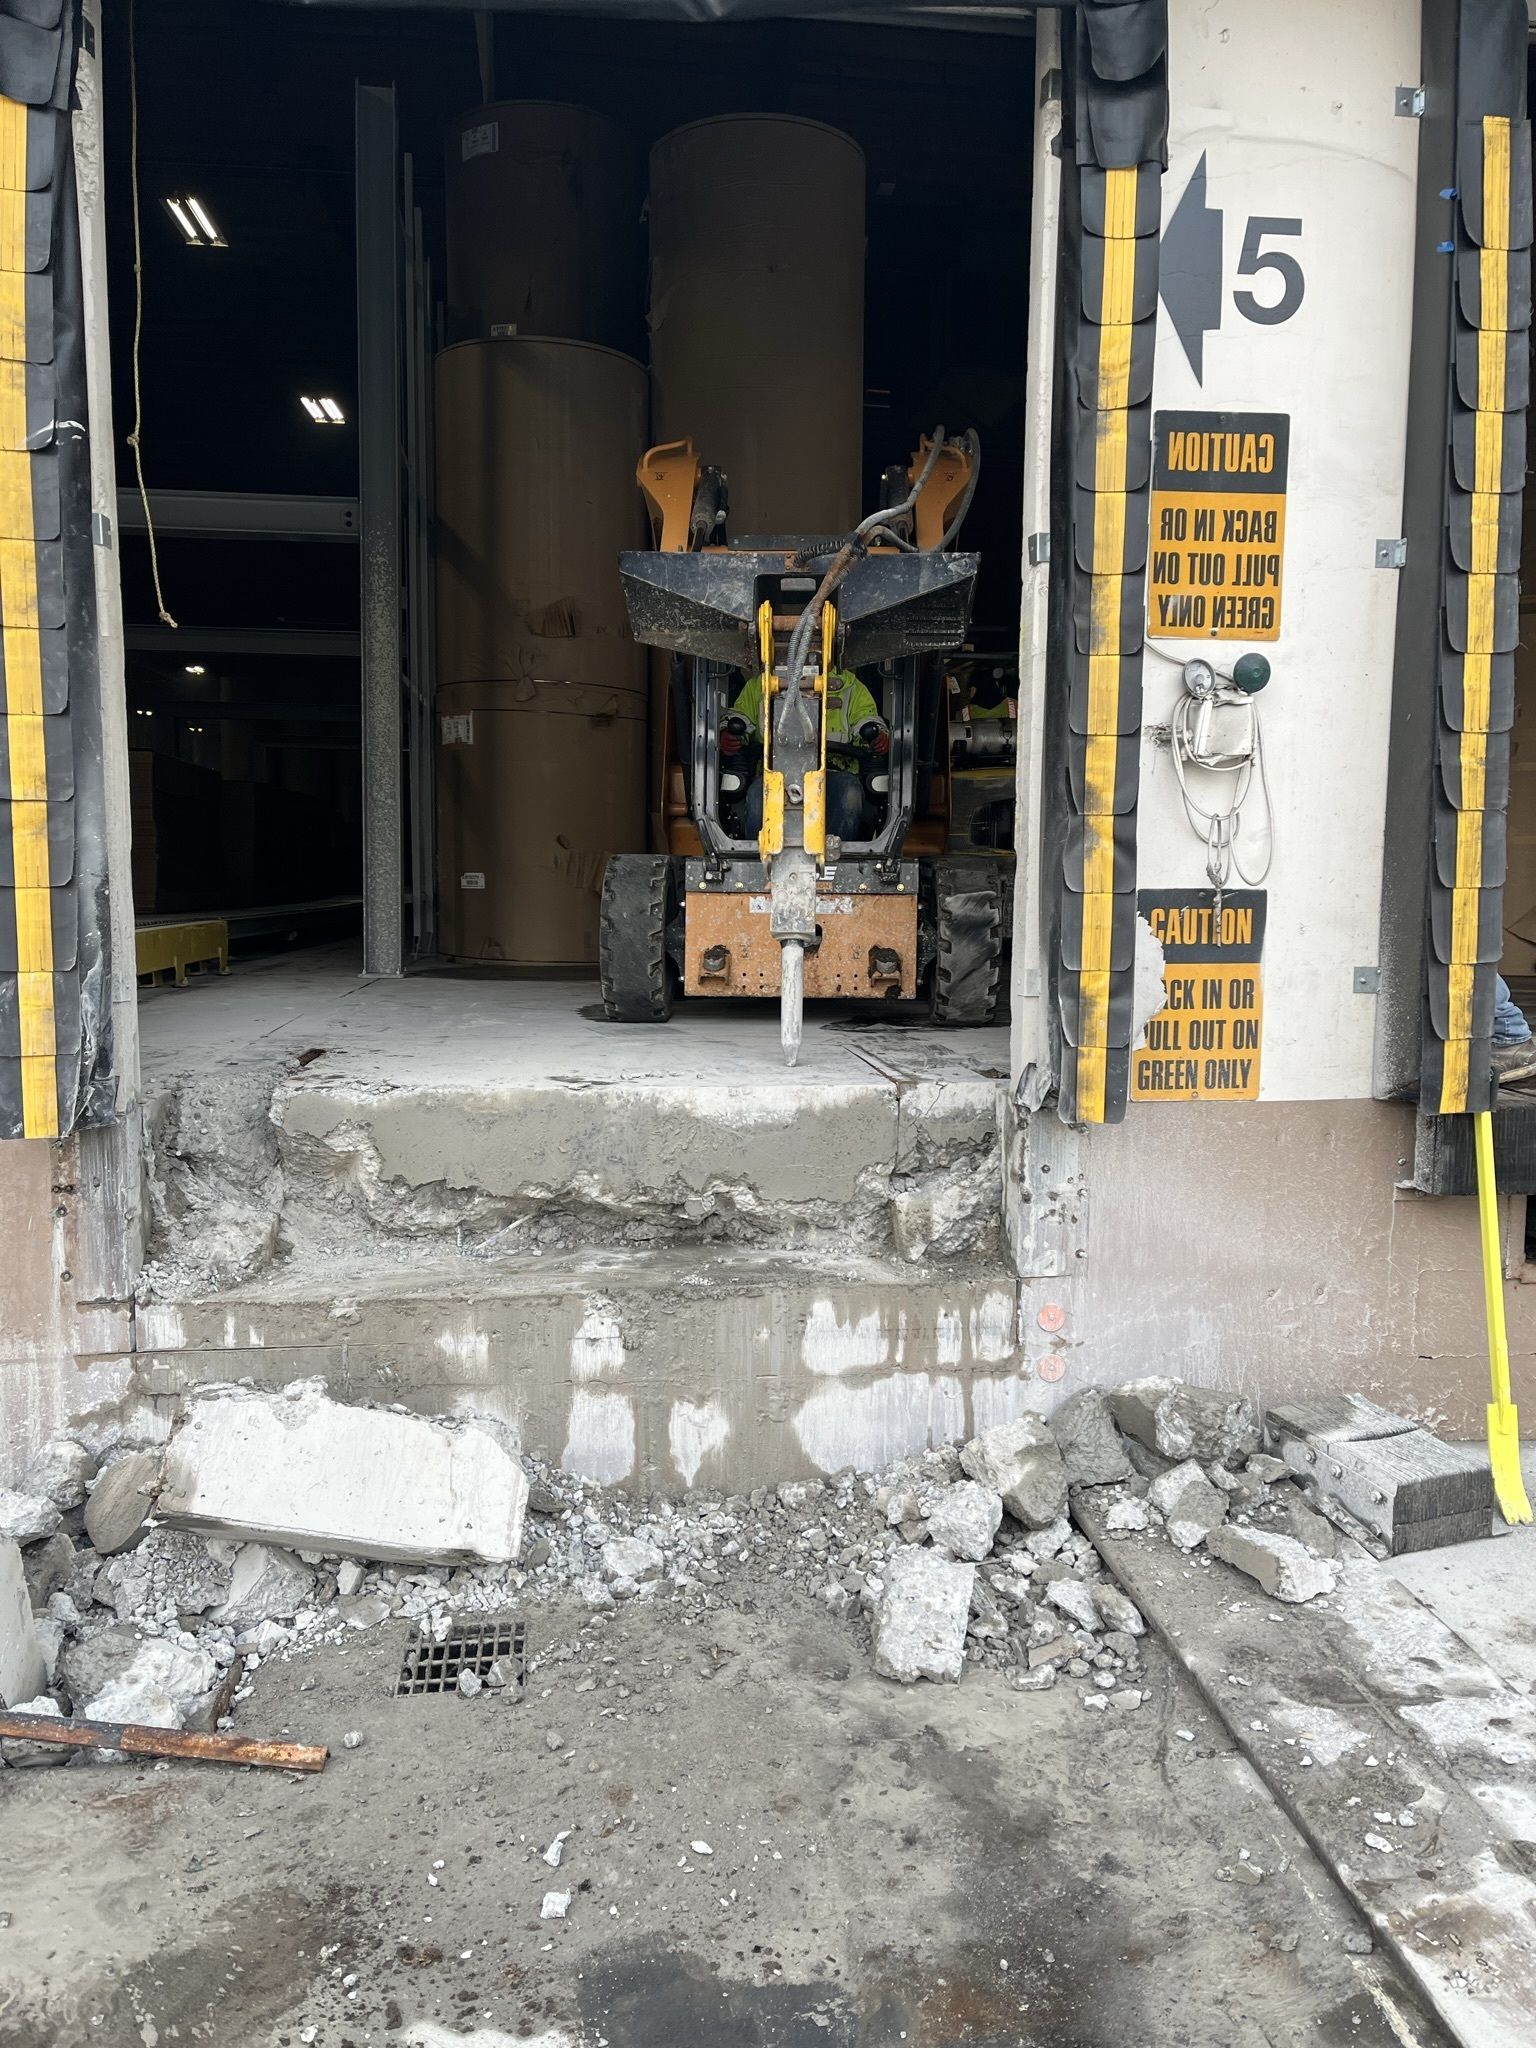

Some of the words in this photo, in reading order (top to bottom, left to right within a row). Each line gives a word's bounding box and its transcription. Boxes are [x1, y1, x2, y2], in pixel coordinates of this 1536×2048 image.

[1233, 216, 1305, 326] 5
[1161, 979, 1195, 1010] CK
[1202, 978, 1222, 1009] IN
[1229, 978, 1255, 1009] OR
[1143, 1020, 1181, 1051] ULL
[1189, 1019, 1227, 1050] OUT
[1233, 1019, 1259, 1050] ON
[1138, 1059, 1199, 1091] GREEN
[1205, 1058, 1253, 1089] ONLY
